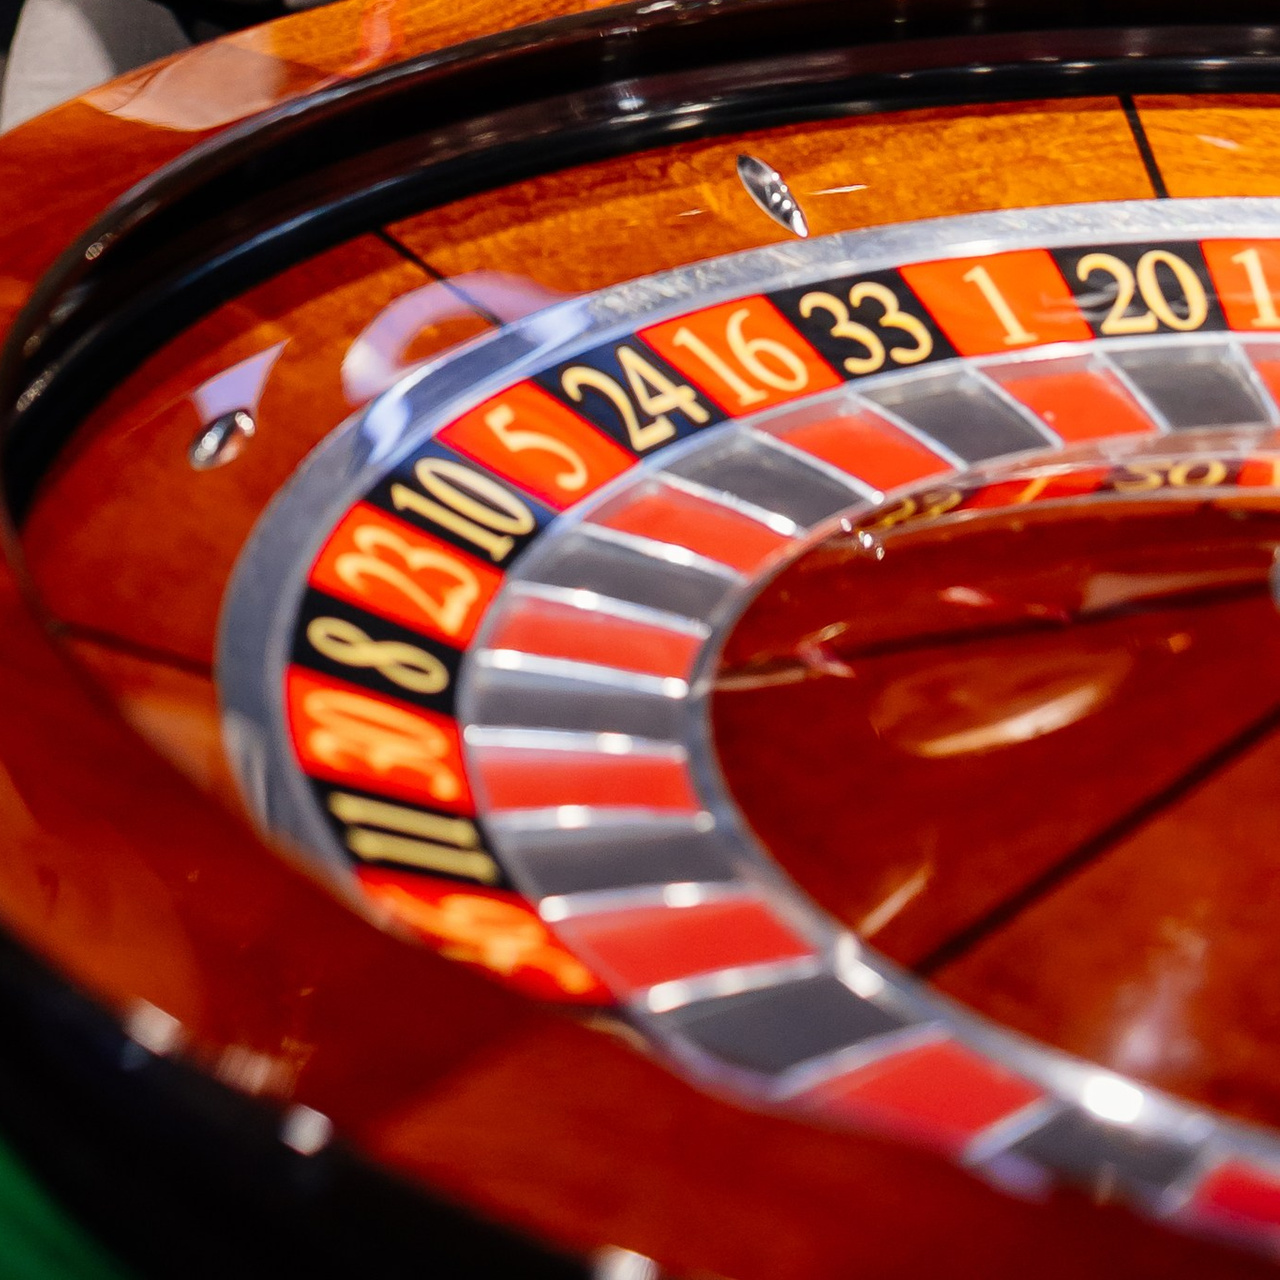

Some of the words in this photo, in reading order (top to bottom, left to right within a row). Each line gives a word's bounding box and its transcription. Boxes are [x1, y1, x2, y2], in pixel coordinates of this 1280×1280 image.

[798, 281, 934, 376] 33
[963, 264, 1037, 346] 1
[1076, 249, 1209, 335] 20
[1231, 248, 1280, 327] 1
[561, 345, 711, 452] 24
[673, 308, 809, 407] 16
[484, 403, 588, 491] 5
[390, 455, 537, 562] 10
[334, 524, 480, 636] 23
[306, 616, 450, 694] 8
[327, 788, 501, 884] 11
